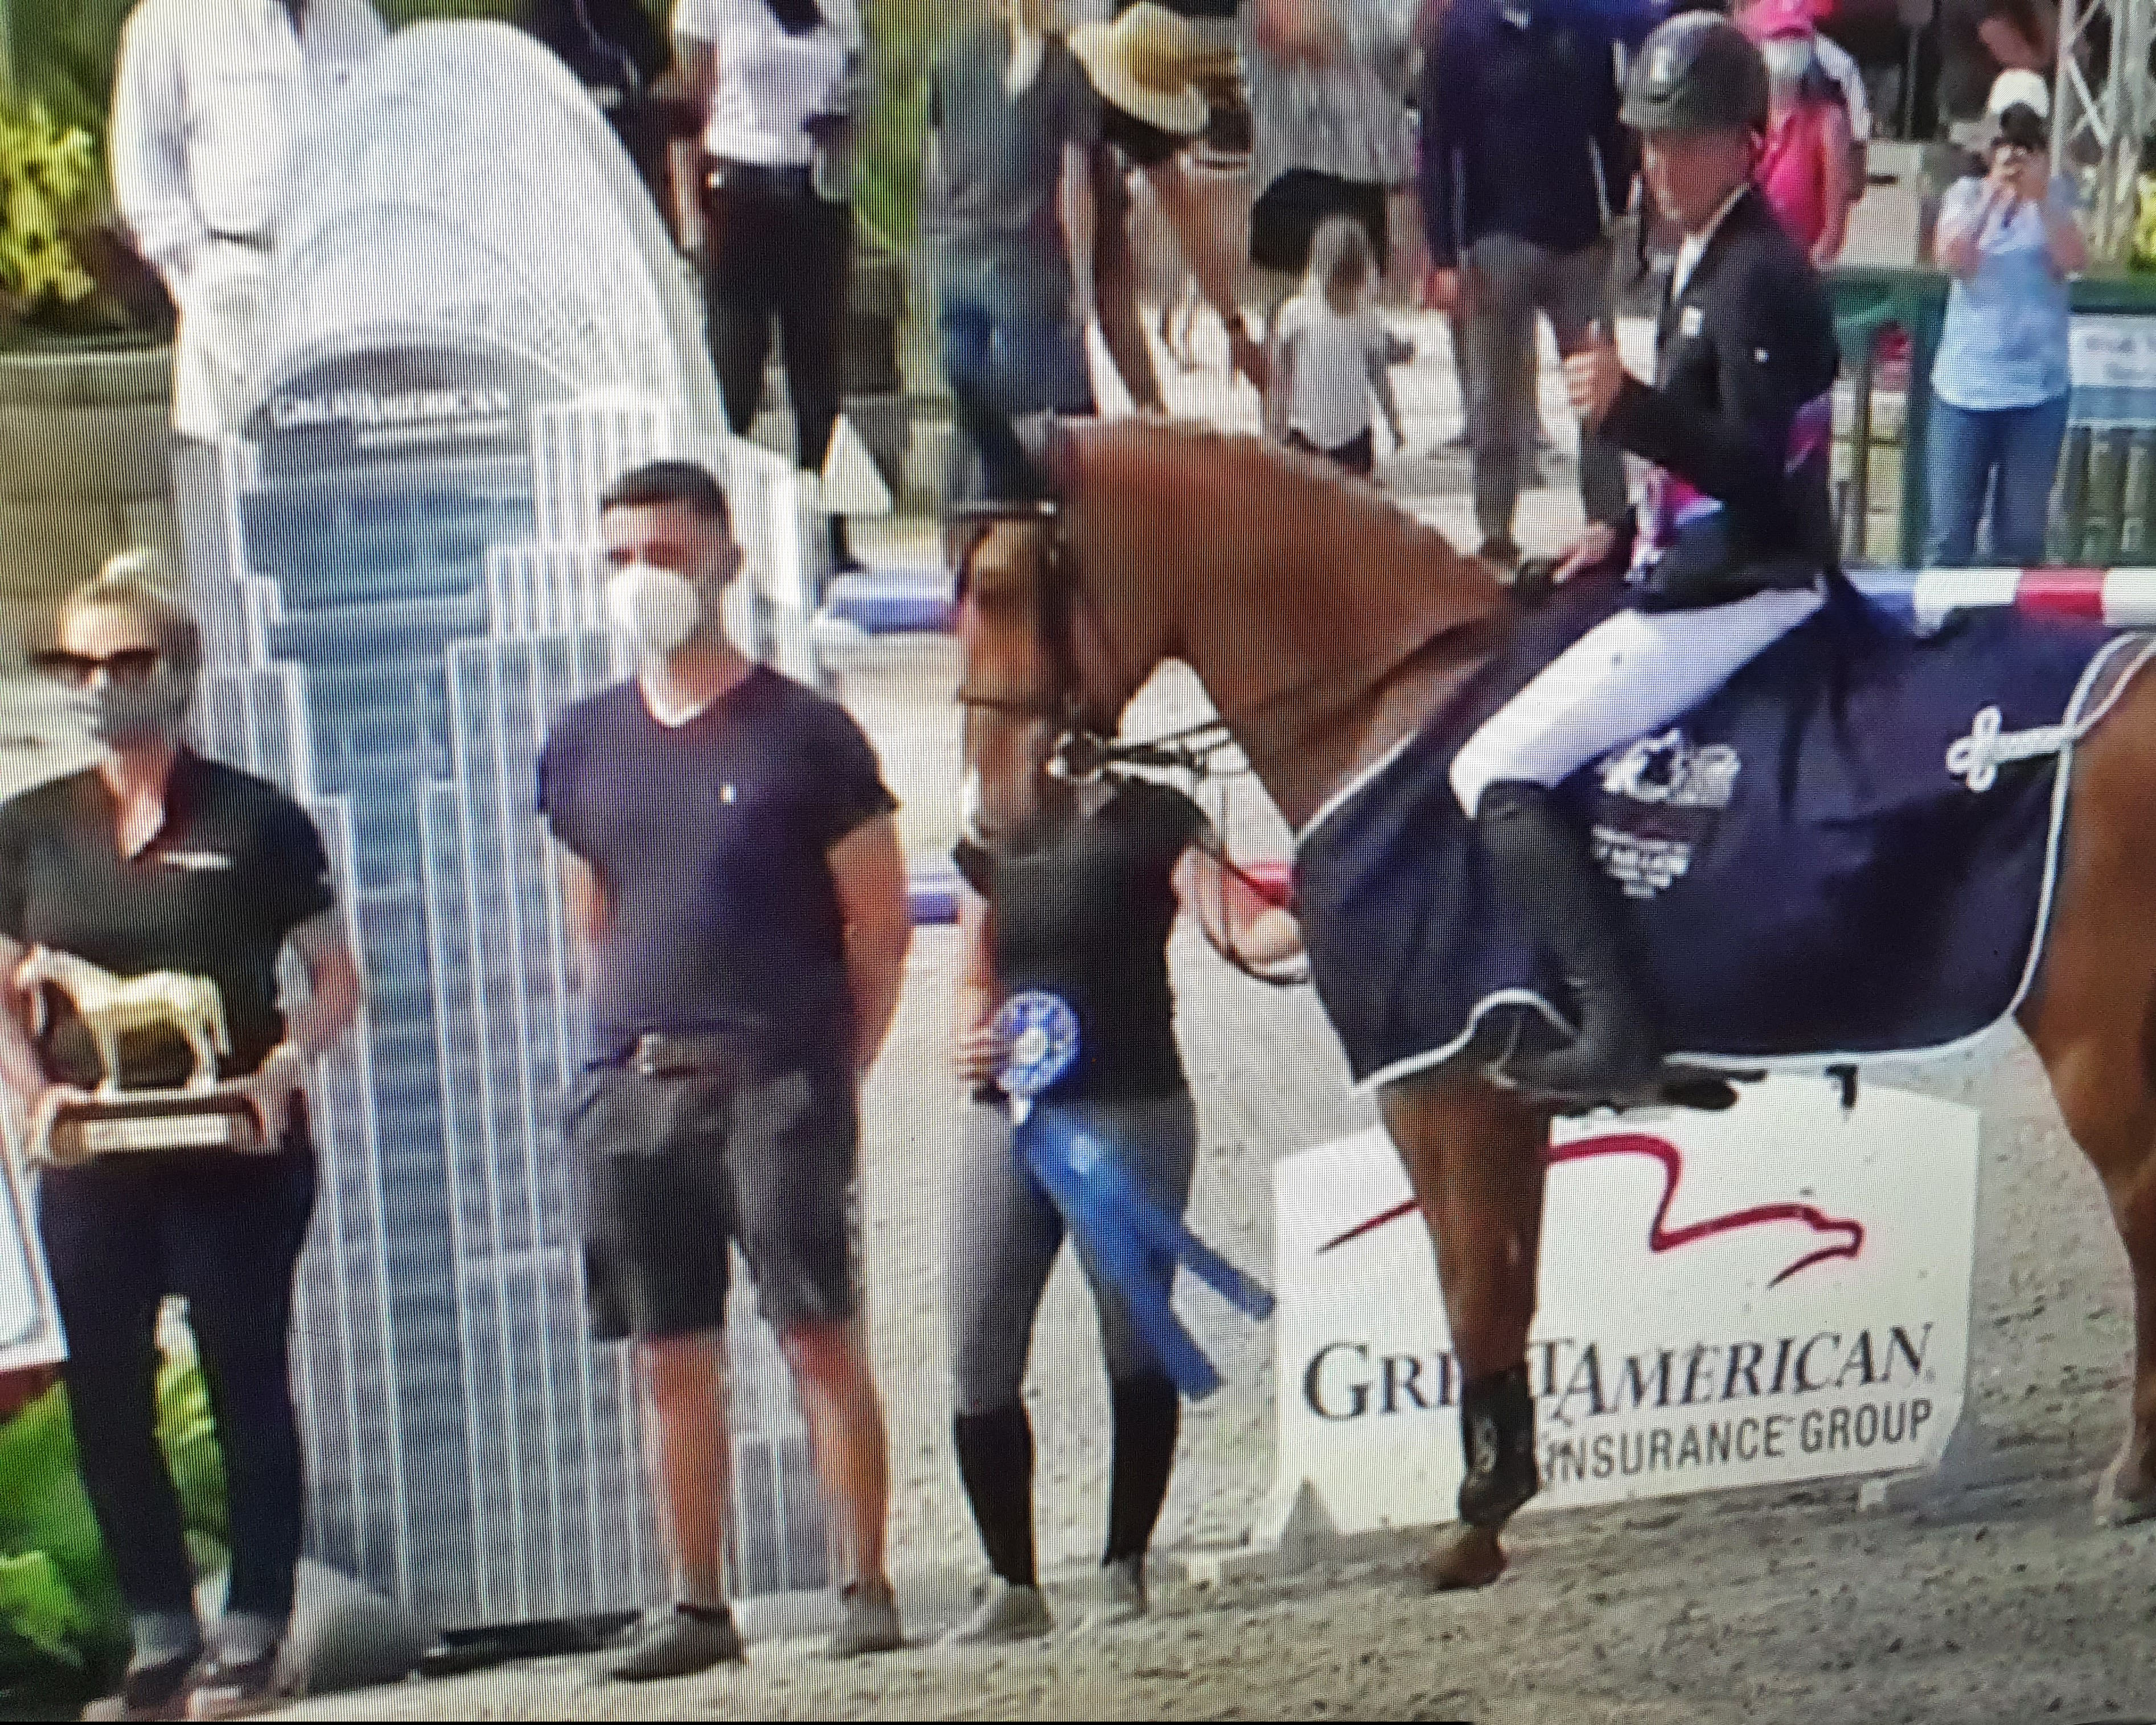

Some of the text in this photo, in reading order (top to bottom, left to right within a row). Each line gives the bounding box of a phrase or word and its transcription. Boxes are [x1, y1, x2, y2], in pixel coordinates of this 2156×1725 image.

[1302, 1321, 1932, 1421] GRT AMERICAN
[1544, 1414, 1784, 1480] INSURANCE
[1799, 1398, 1933, 1453] GROUP
